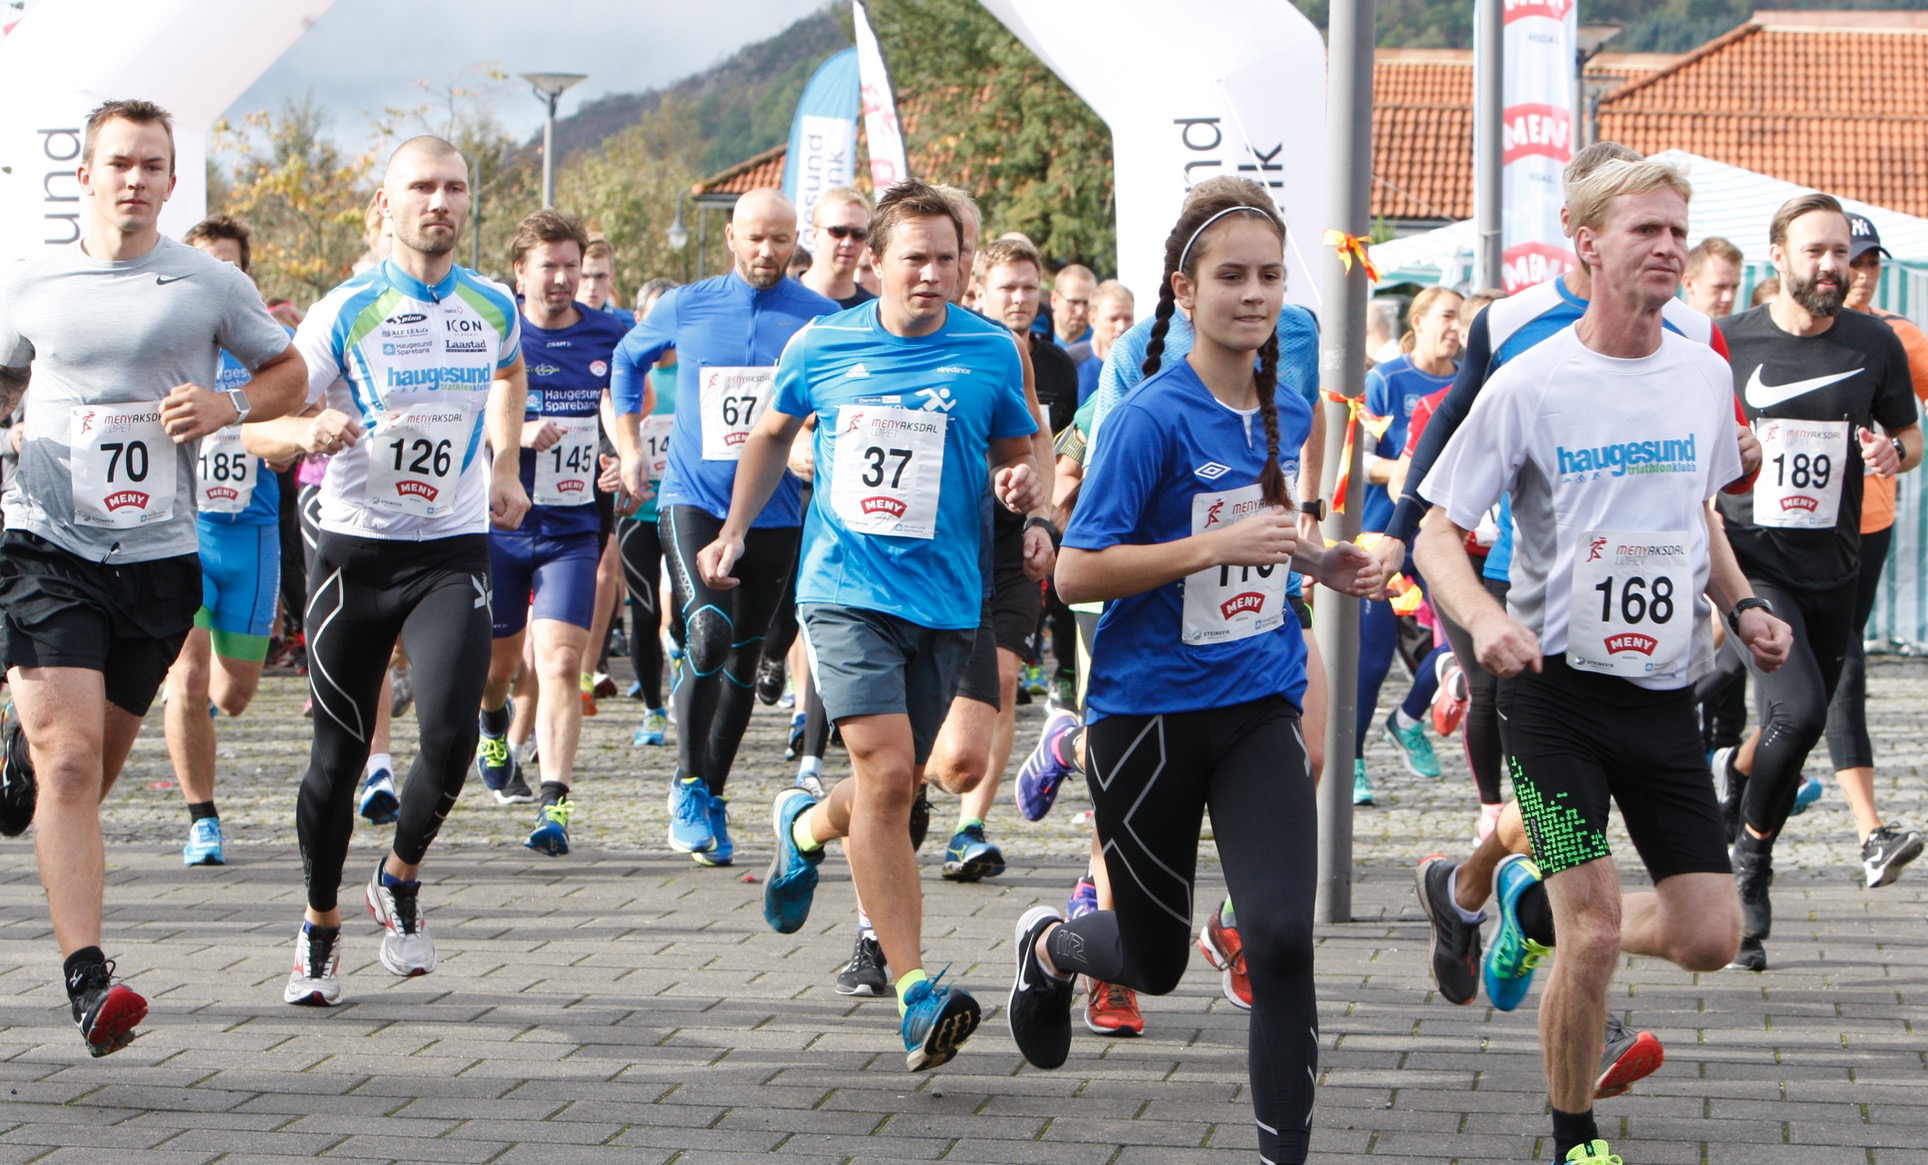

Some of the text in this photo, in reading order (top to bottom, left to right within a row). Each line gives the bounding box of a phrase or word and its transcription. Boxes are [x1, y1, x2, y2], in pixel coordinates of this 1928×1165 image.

[446, 319, 483, 333] ICON
[445, 340, 487, 349] Laastad
[387, 363, 491, 391] haugesund
[407, 413, 463, 424] MENYAKSDAL
[723, 396, 757, 426] 67
[871, 418, 938, 433] MENYAKSDAL
[1786, 429, 1842, 439] MENYAKSDAL
[100, 440, 149, 483] 70
[390, 438, 452, 477] 126
[551, 445, 592, 473] 145
[1556, 433, 1696, 477] haugesund
[199, 453, 247, 481] 185
[862, 446, 913, 489] 37
[1773, 453, 1831, 489] 189
[400, 483, 435, 497] MENY
[108, 494, 145, 507] MENY
[865, 500, 902, 513] MENY
[1784, 497, 1815, 508] MENY
[1616, 545, 1685, 556] MENYAKSDAL
[1226, 596, 1262, 614] MENY
[1596, 576, 1674, 624] 168
[1610, 637, 1653, 650] MENY
